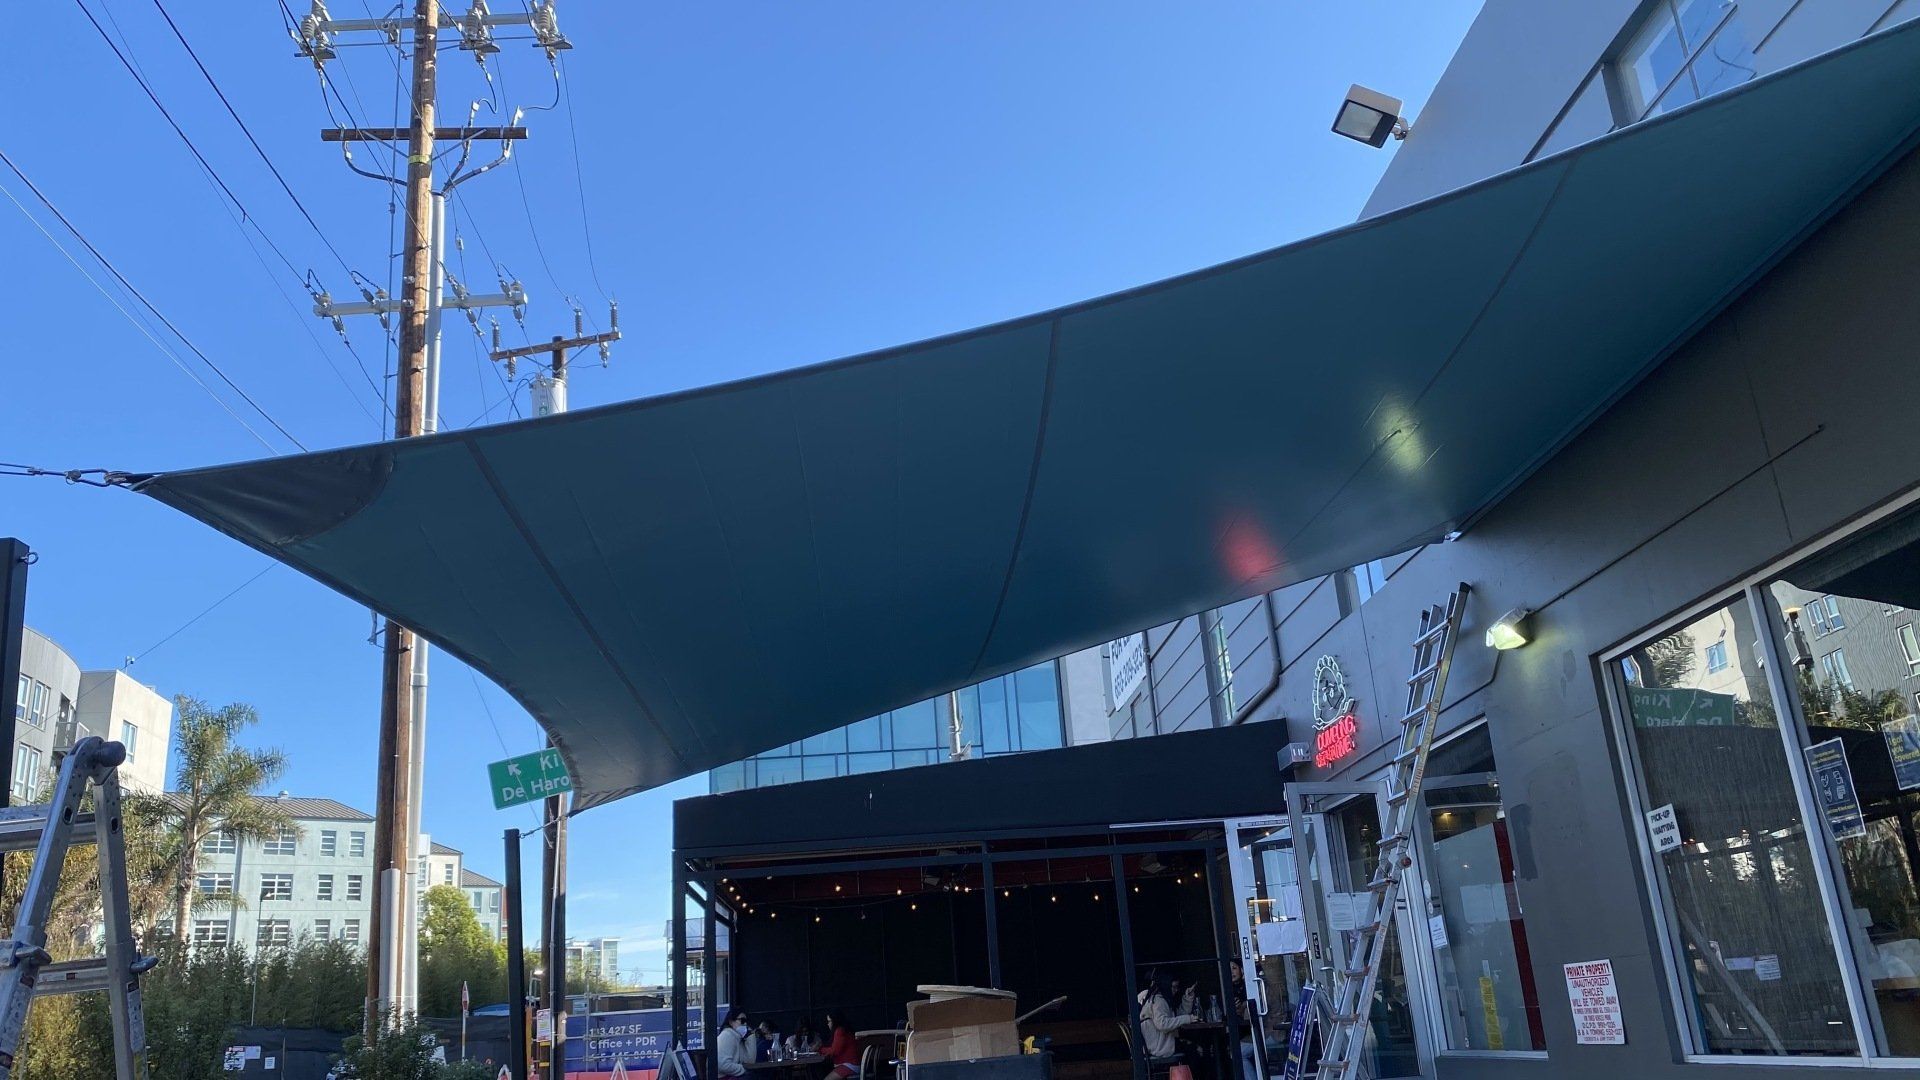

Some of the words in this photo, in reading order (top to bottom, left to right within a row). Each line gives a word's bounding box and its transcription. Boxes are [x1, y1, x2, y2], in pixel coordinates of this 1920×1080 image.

[540, 754, 563, 771] Ki
[502, 786, 525, 802] De
[530, 775, 570, 795] Haro
[1650, 809, 1671, 823] PICK-UP
[1652, 821, 1675, 835] WAITING
[1660, 835, 1675, 847] AREA
[1566, 965, 1585, 977] PRIVATE
[1585, 963, 1610, 975] PROPERTY
[1571, 977, 1610, 988] UNAUTHORIZED
[1580, 987, 1604, 997] VEHICLES
[1571, 998, 1582, 1007] WILL
[1582, 997, 1589, 1006] BE
[1589, 997, 1605, 1006] TOWED
[1605, 996, 1617, 1005] AWAY
[628, 1024, 642, 1034] SF
[635, 1037, 657, 1047] PDR
